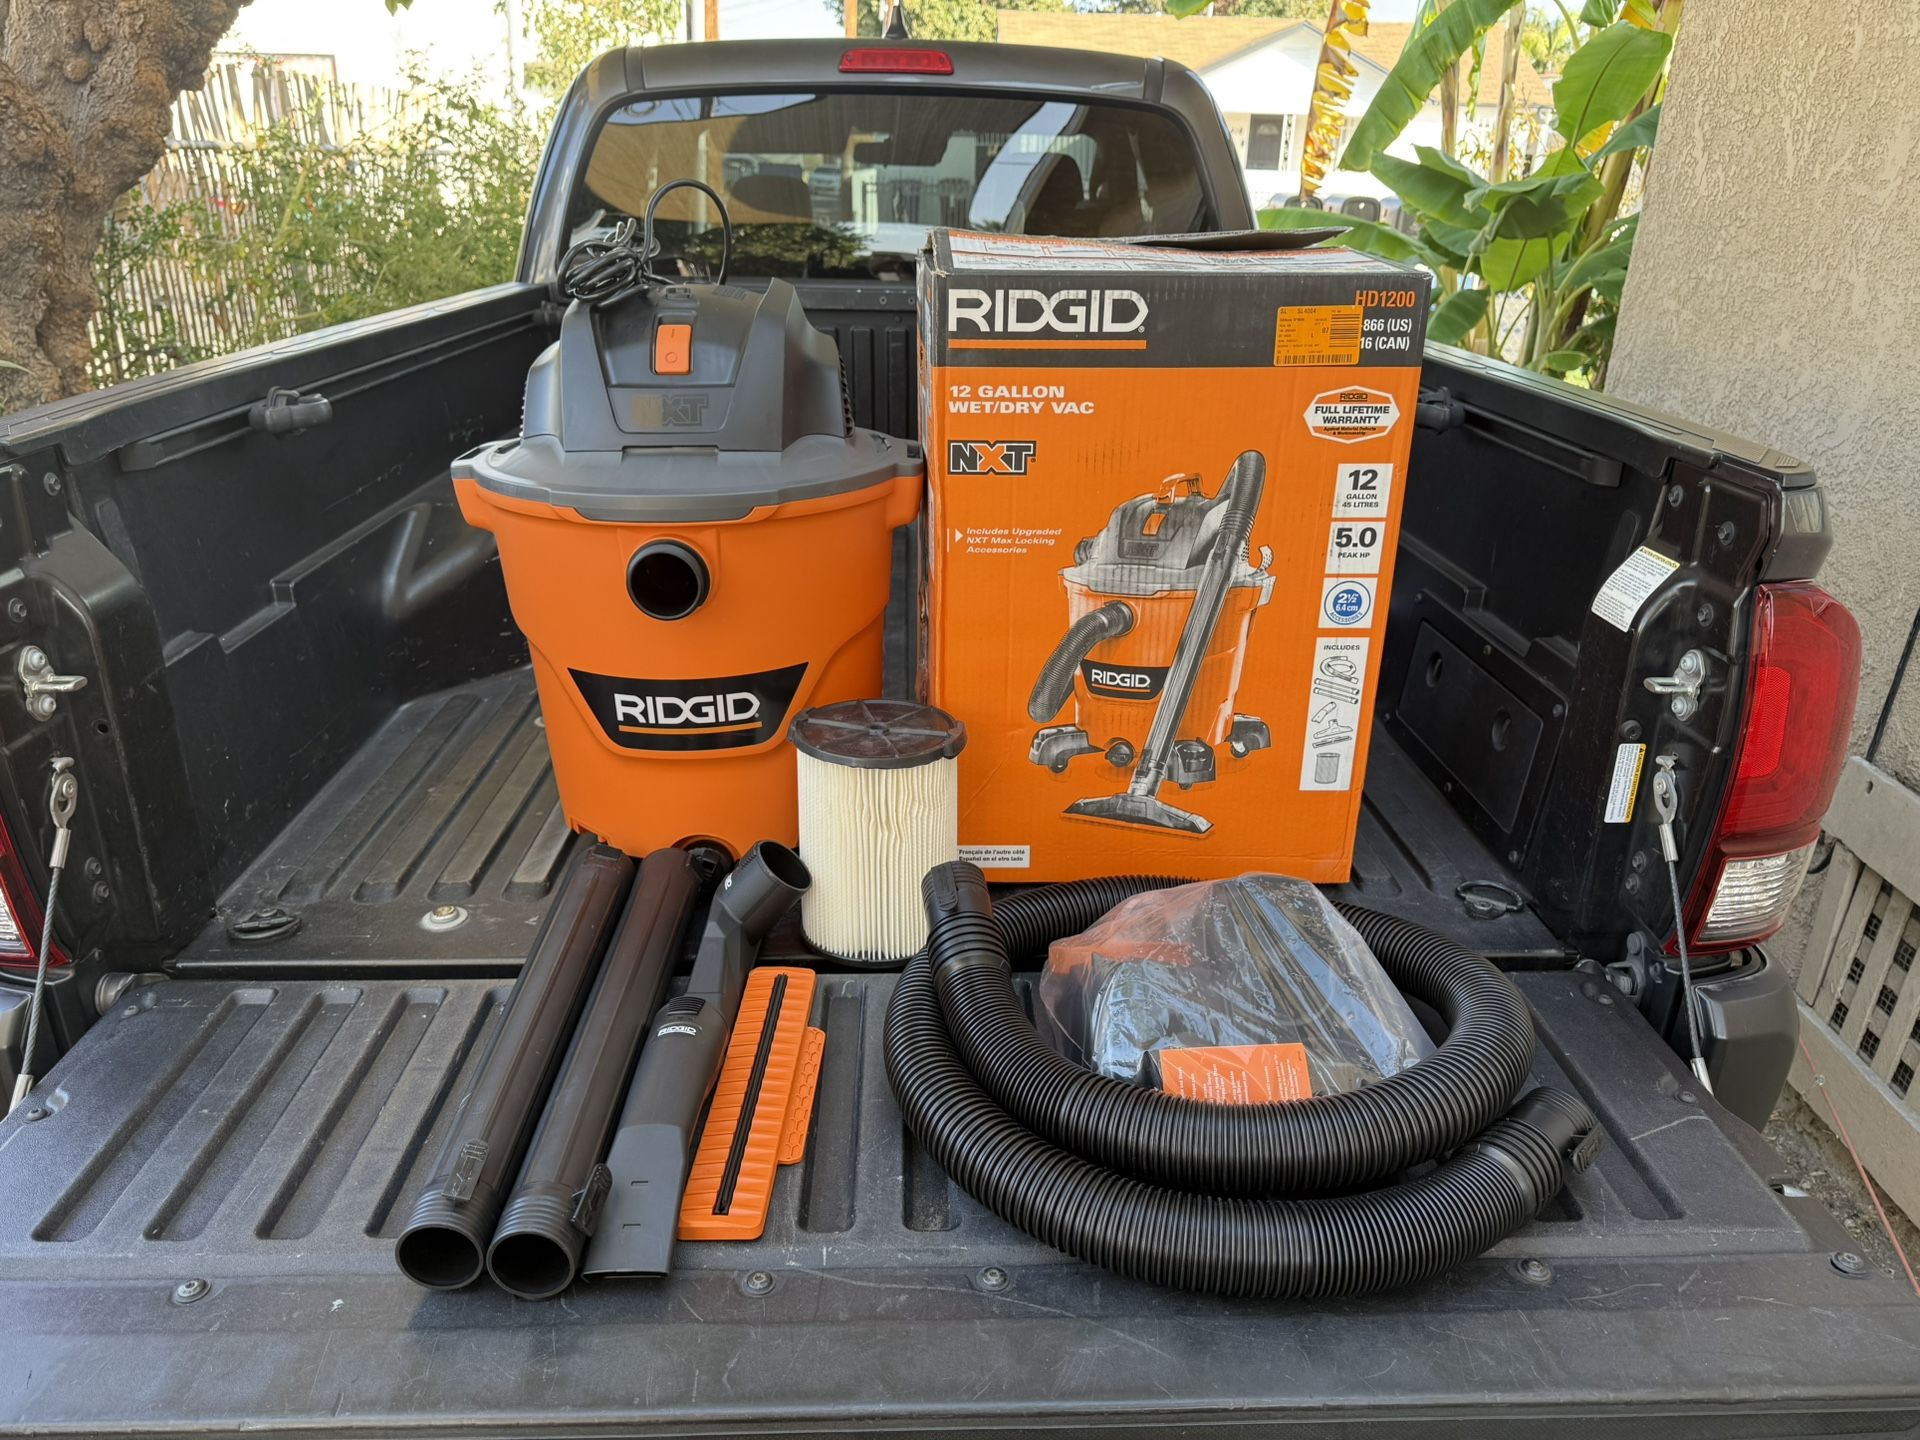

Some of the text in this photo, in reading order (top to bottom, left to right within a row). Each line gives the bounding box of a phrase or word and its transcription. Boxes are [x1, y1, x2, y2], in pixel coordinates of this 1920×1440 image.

[1355, 290, 1416, 308] HD1200
[948, 288, 1149, 333] RIDGID
[1387, 317, 1412, 334] (US)
[1374, 335, 1410, 351] (CAN)
[950, 385, 1065, 398] 12 GALLON
[1339, 392, 1368, 400] RIDGID
[949, 401, 1095, 414] WET/DRY VAC
[1314, 405, 1390, 415] FULL LIFETIME
[1322, 415, 1380, 424] WARRANTY
[948, 440, 1036, 475] NXT
[1348, 469, 1378, 491] 12
[1012, 528, 1062, 537] Upgraded
[1335, 527, 1377, 548] 5.0
[1015, 537, 1056, 546] Locking
[966, 546, 1028, 554] Accessories
[1335, 603, 1346, 612] 6.4
[1092, 669, 1151, 688] RIDGID
[614, 691, 761, 725] RIDGID
